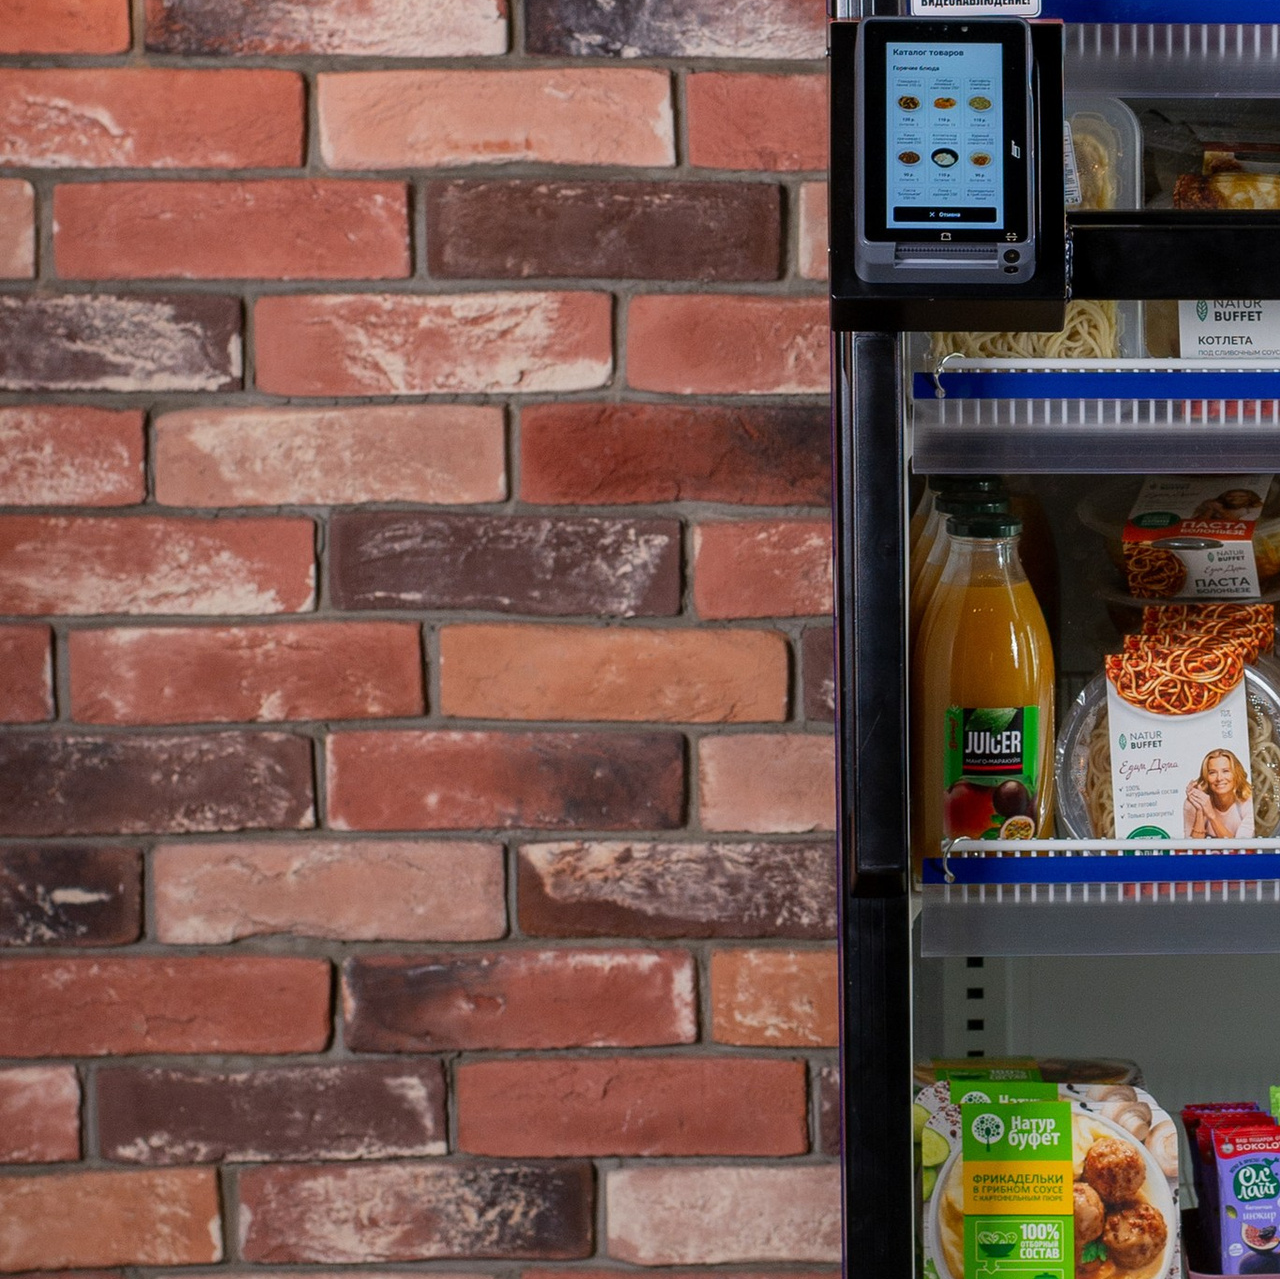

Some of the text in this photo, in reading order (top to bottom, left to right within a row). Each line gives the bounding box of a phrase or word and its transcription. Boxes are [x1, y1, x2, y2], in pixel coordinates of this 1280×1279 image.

[893, 48, 964, 57] Каталог товаров
[1213, 300, 1262, 309] NATUR
[1214, 311, 1263, 322] BUFFET
[1198, 336, 1253, 345] КОТЛЕТА
[1198, 349, 1214, 357] ПОД
[1180, 522, 1247, 530] ПАСТА
[1195, 577, 1250, 588] ПАСТА
[1129, 730, 1162, 741] NATUR
[965, 731, 1022, 754] JUICER
[1130, 740, 1163, 750] BUFFET
[1011, 1115, 1056, 1134] Натур
[1008, 1128, 1061, 1151] буфет
[972, 1174, 1064, 1185] ФРИКАДЕЛЬКИ
[973, 1185, 1063, 1194] В ГРИБНОМ СОУСЕ
[1237, 1182, 1277, 1200] лайт
[1242, 1211, 1277, 1222] инжир
[1020, 1223, 1060, 1241] 100%
[1020, 1240, 1059, 1248] ОТБОРНЫЙ
[1020, 1248, 1060, 1259] СОСТАВ
